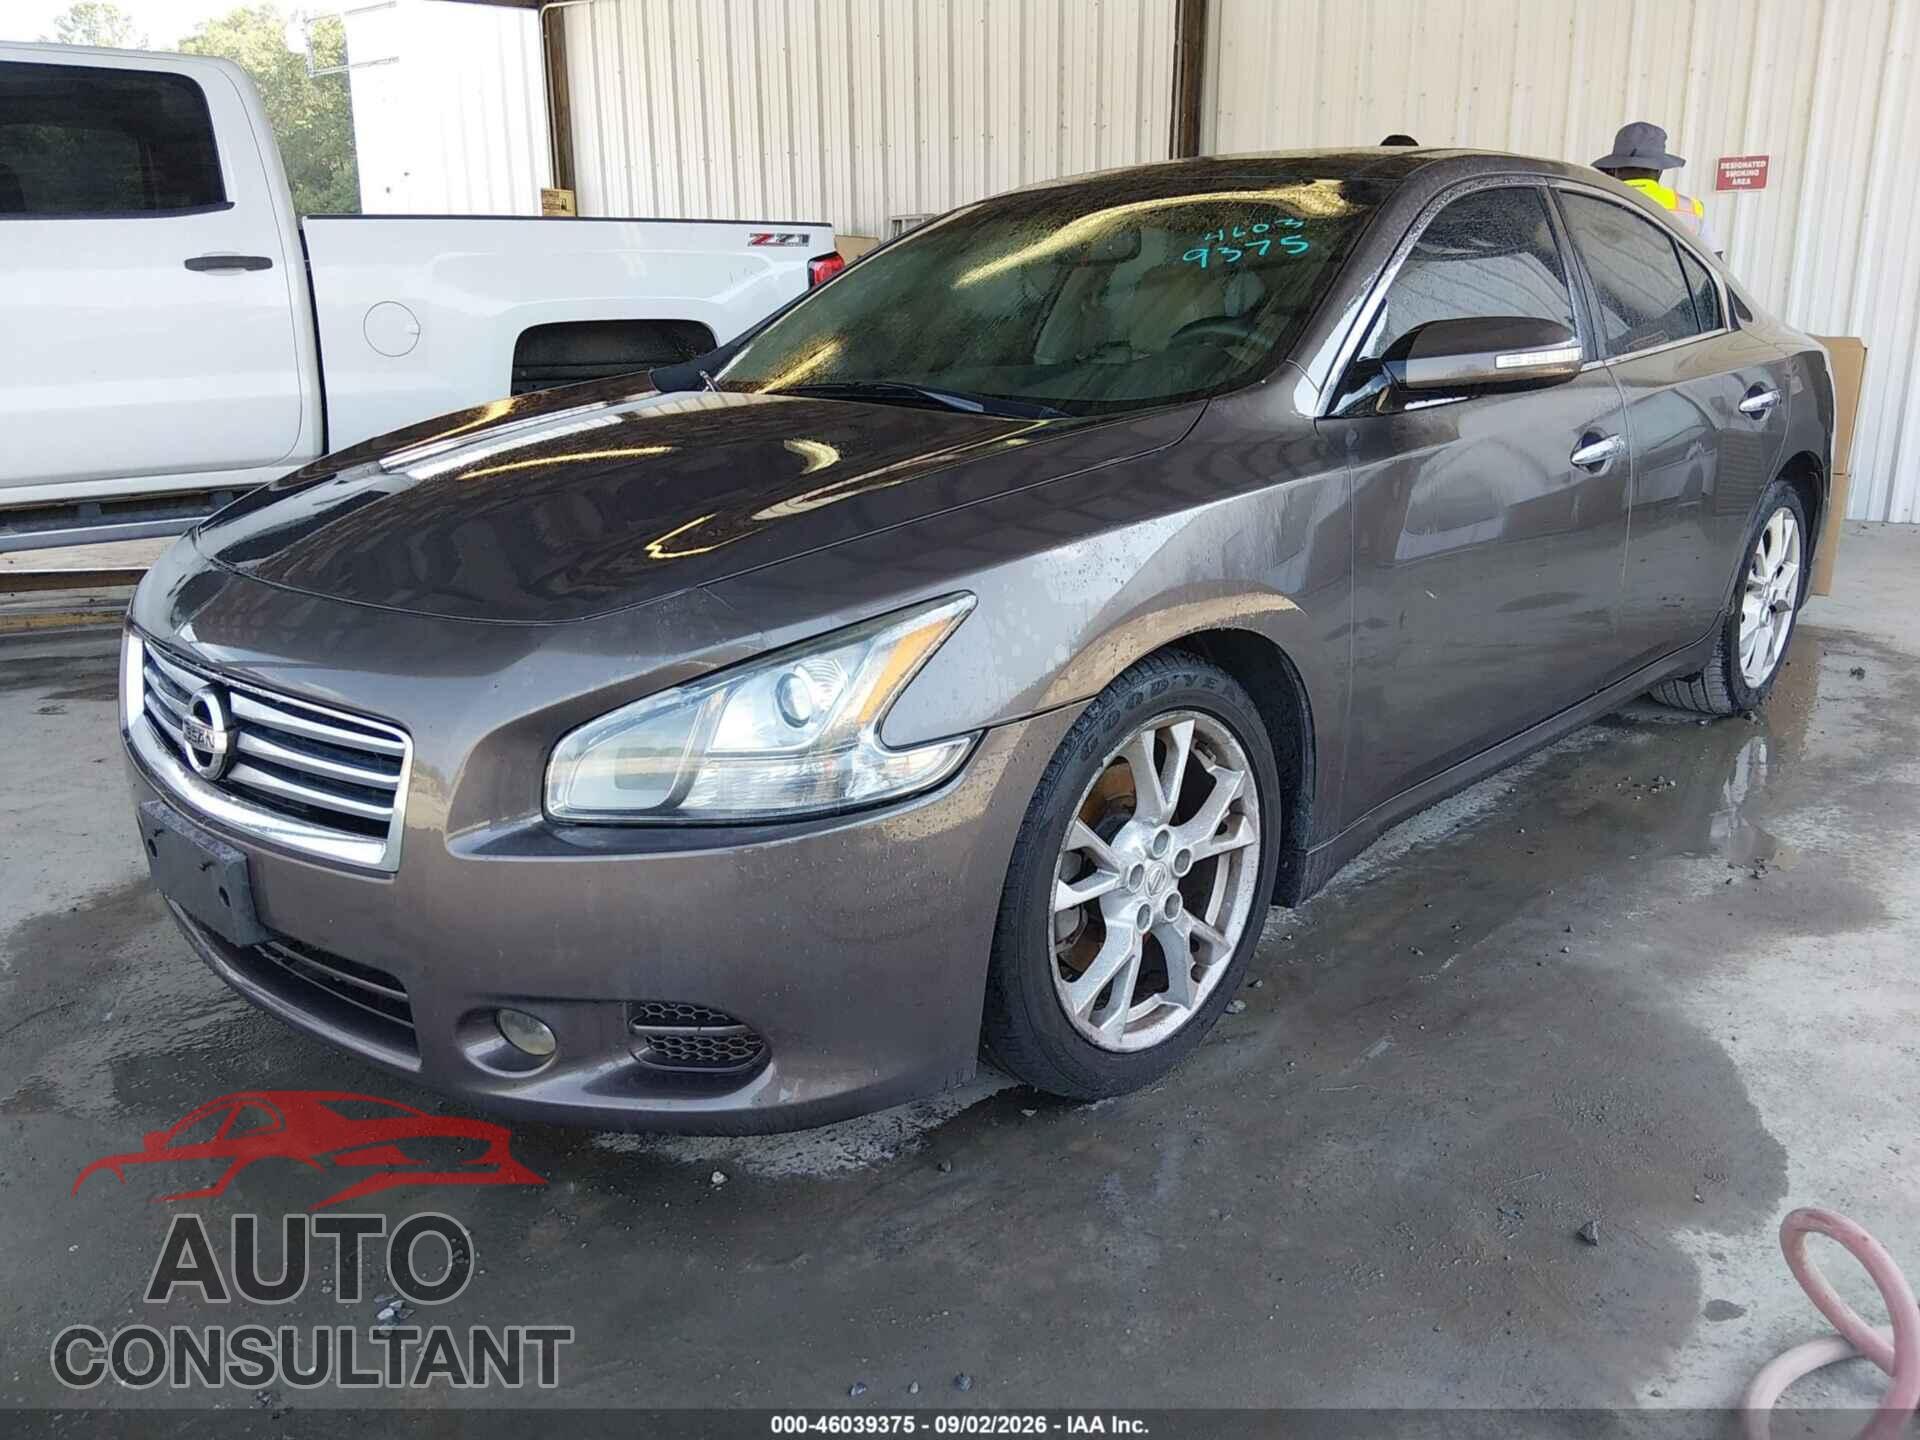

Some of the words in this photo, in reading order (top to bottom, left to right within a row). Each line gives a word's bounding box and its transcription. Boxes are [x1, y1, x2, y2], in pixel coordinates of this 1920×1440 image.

[1720, 160, 1767, 170] DESIGNATED
[1725, 169, 1760, 178] SMOKING
[1731, 177, 1752, 185] AREA
[748, 232, 811, 247] Z71
[1182, 234, 1310, 269] 9375
